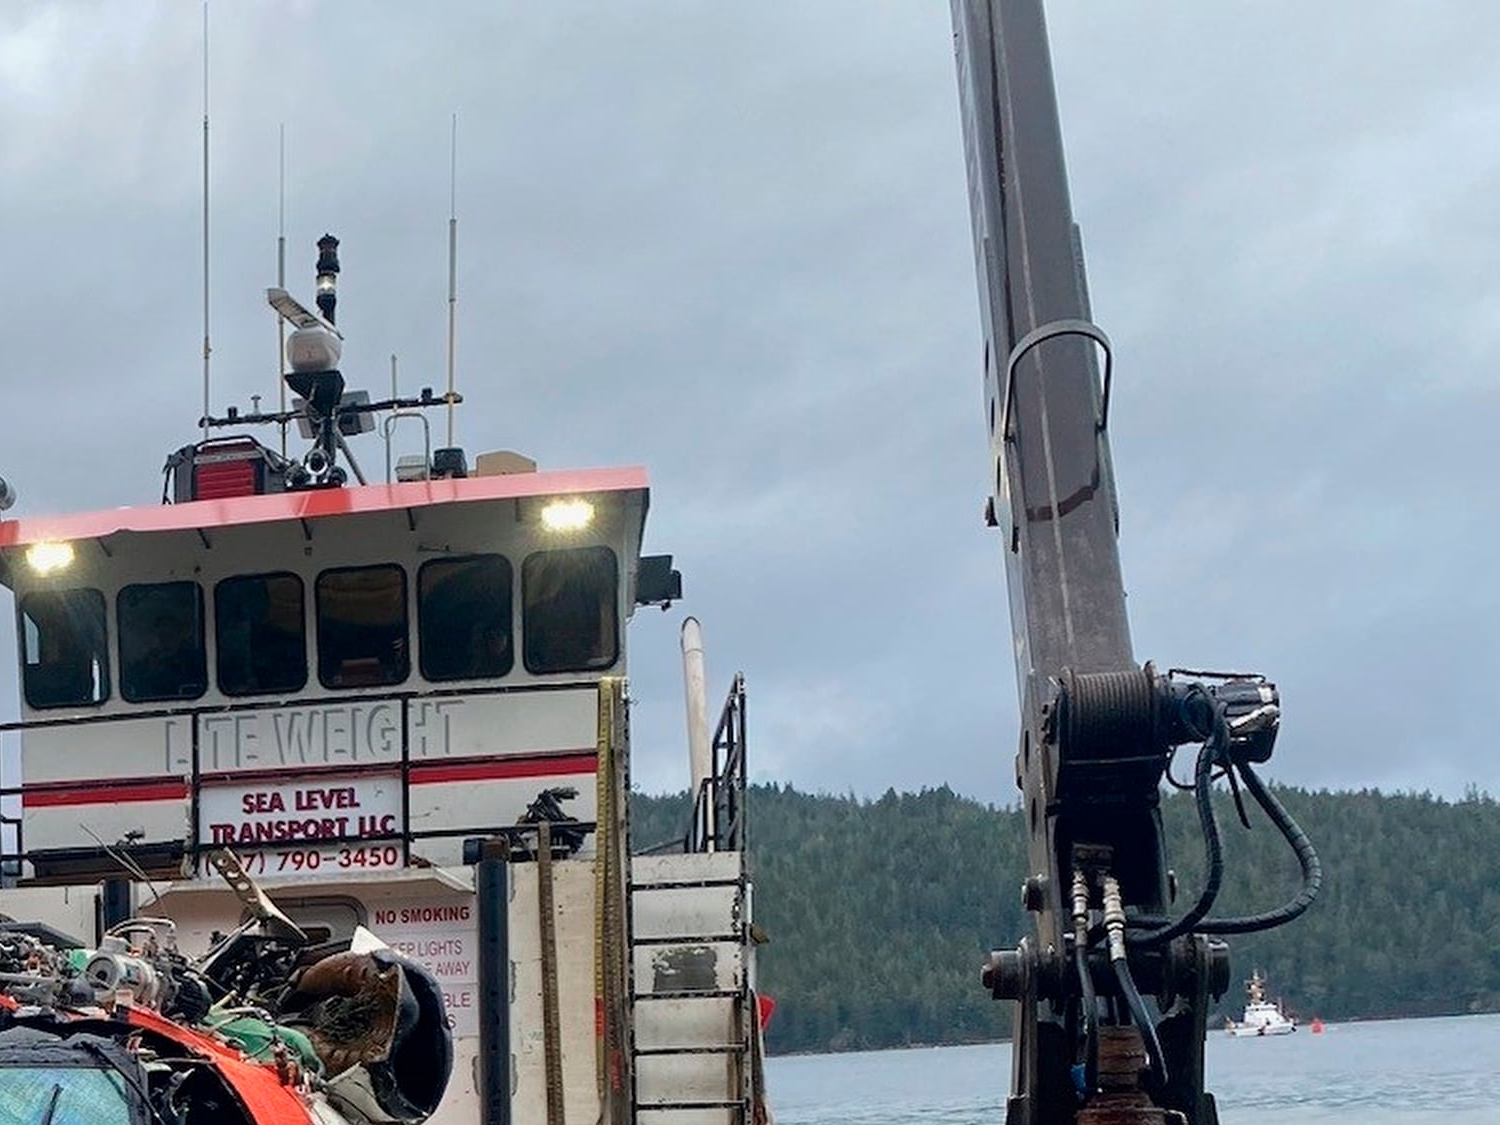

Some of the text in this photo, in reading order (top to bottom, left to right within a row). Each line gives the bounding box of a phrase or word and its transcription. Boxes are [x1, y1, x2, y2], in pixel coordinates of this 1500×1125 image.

[164, 700, 465, 773] LTE WEIGHT
[242, 787, 361, 814] SEA LEVEL
[209, 814, 397, 846] TRANSPORT LLC
[205, 847, 398, 877] (7) 790-3450
[375, 906, 471, 925] NO SMOKING
[418, 939, 463, 957] LIGHTS
[435, 961, 471, 977] AWAY
